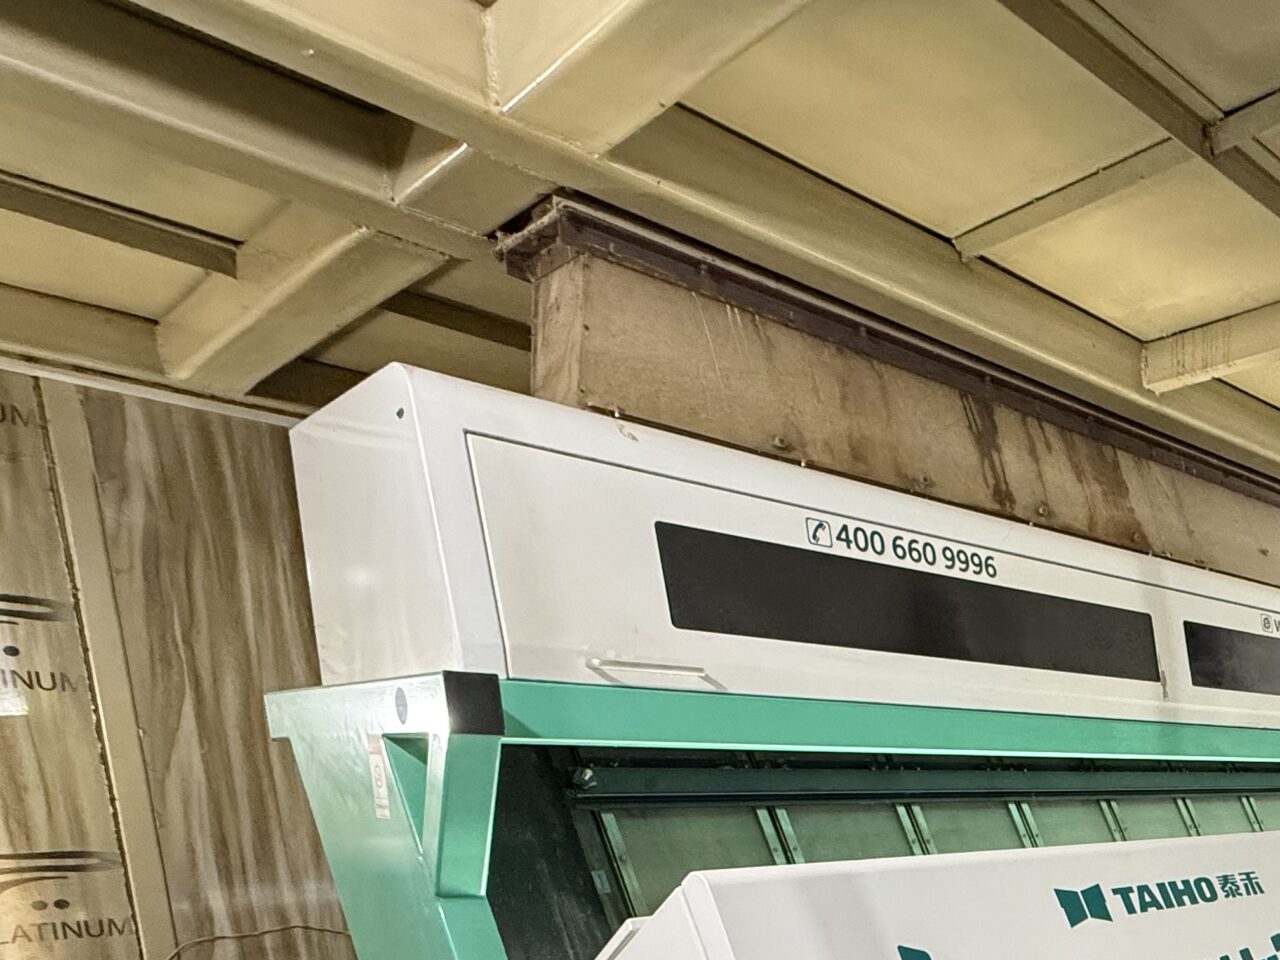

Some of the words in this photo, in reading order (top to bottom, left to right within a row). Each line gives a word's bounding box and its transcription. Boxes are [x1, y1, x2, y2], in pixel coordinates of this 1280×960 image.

[836, 524, 885, 556] 400
[892, 535, 937, 567] 660
[942, 546, 998, 579] 9996
[1111, 876, 1218, 915] TAIHO
[1216, 870, 1265, 899] 泰禾
